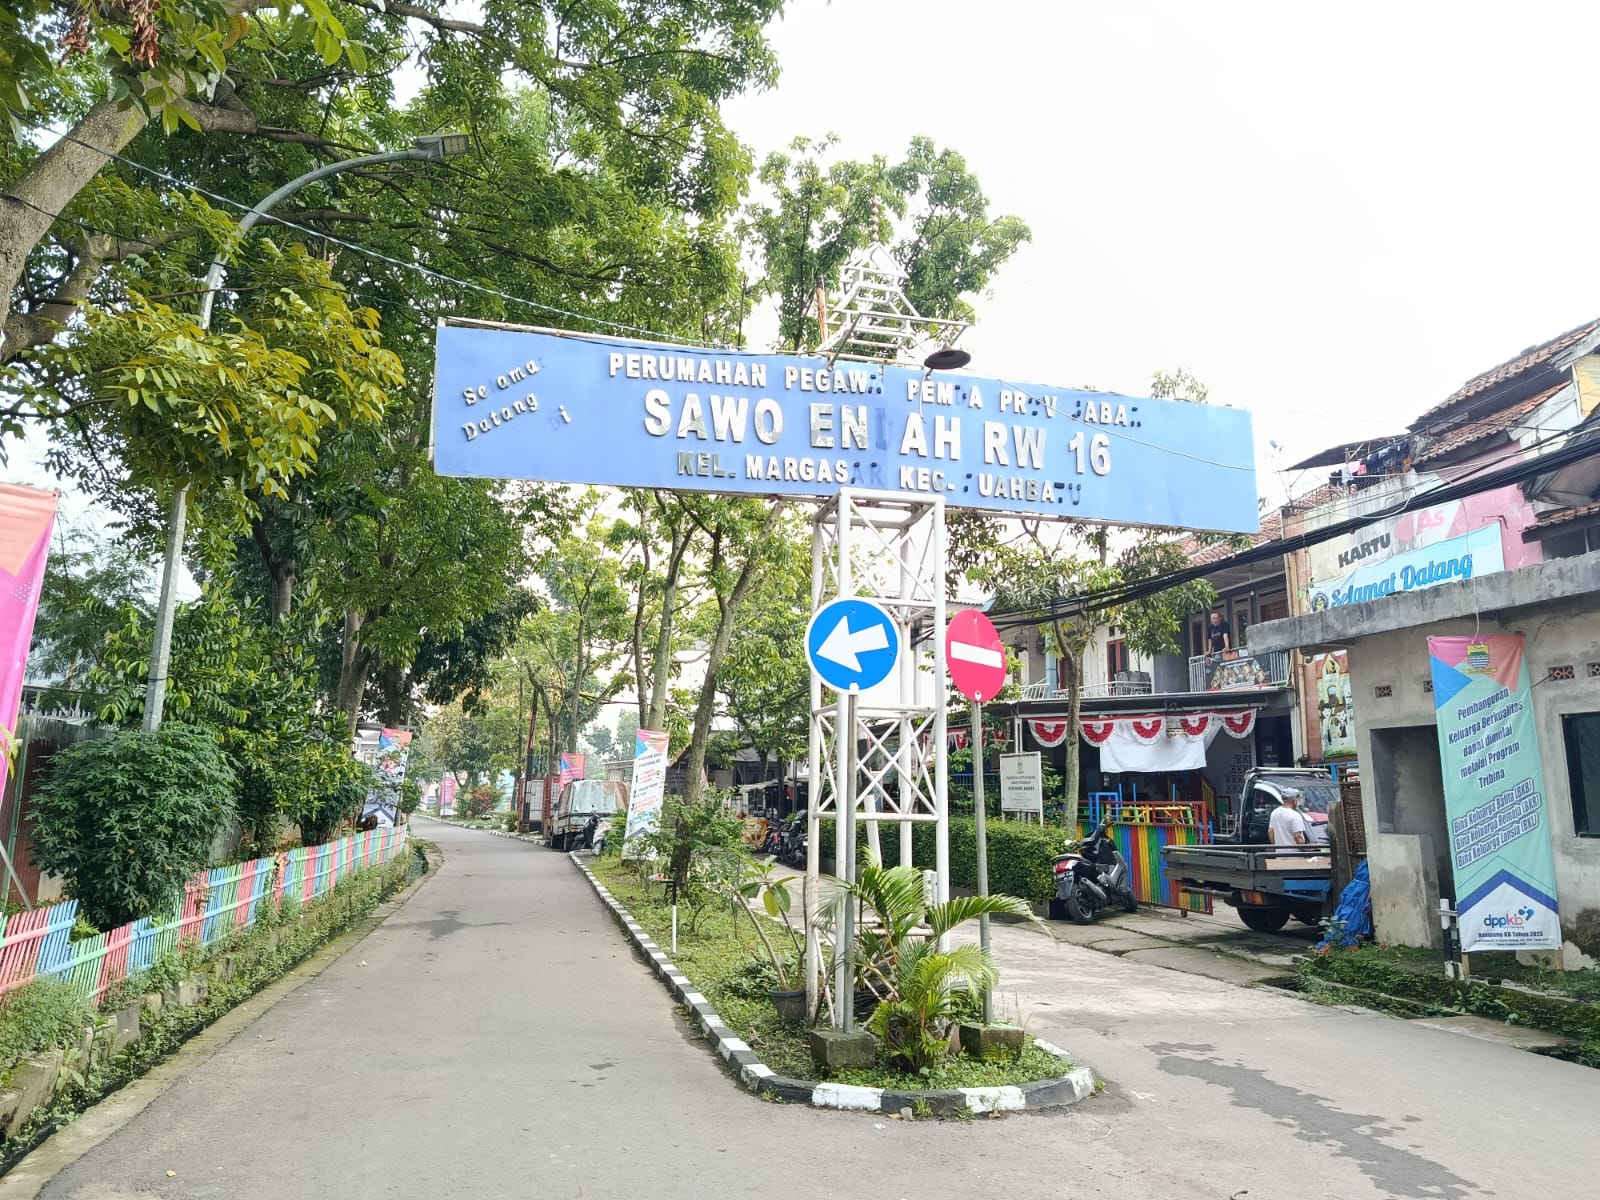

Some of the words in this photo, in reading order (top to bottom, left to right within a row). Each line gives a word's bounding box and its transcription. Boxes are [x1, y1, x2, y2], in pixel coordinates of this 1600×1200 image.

[609, 351, 767, 388] PERUMAHAN
[1000, 388, 1058, 418] PRV
[461, 392, 539, 442] Datang
[643, 388, 784, 445] SAWO
[810, 401, 961, 461] ENAH
[983, 420, 1047, 470] RW
[1069, 431, 1112, 477] 16
[678, 450, 736, 479] KEL.
[899, 465, 955, 493] KEC.
[1338, 533, 1391, 568] KARTU
[1331, 571, 1396, 608] Selamat
[1399, 553, 1473, 590] Datang
[1448, 721, 1481, 745] Keluarga
[1481, 701, 1523, 729] Berkualitas
[1457, 687, 1509, 721] Pembangunan
[1463, 740, 1485, 757] dapat
[1485, 724, 1513, 747] dimulai
[1460, 756, 1488, 779] melalui
[1488, 741, 1520, 765] Program
[1478, 768, 1505, 789] Tribina
[1454, 816, 1469, 834] Bina
[1468, 801, 1496, 824] Keluarga
[1455, 834, 1470, 850] Bina
[1470, 818, 1498, 842] Keluarga
[1457, 851, 1473, 867] Bina
[1472, 836, 1500, 859] Keluarga
[1500, 824, 1520, 844] Lansia
[1483, 912, 1523, 929] dppkb
